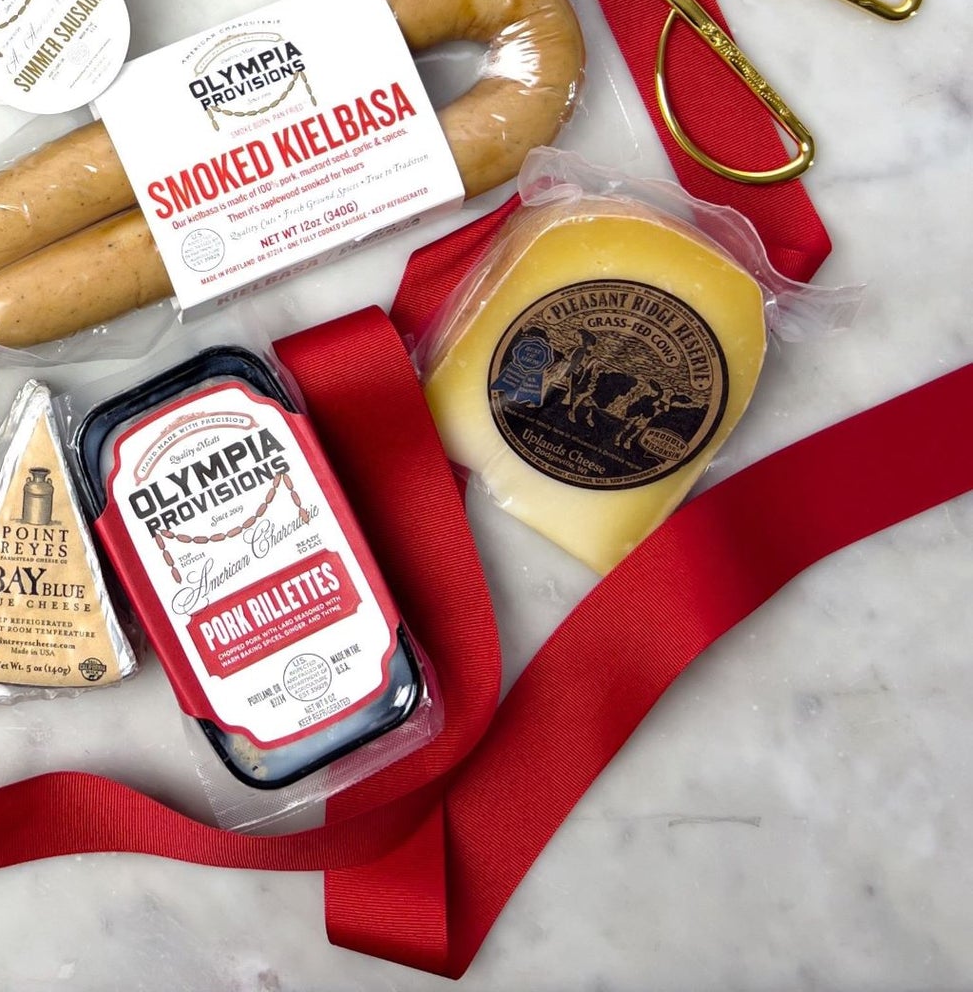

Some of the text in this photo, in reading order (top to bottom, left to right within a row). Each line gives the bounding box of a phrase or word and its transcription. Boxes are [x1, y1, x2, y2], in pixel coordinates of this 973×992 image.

[14, 37, 64, 93] SUMMER
[188, 41, 303, 99] OLYMPIA
[200, 59, 306, 111] PROVISIONS
[148, 82, 417, 220] SMOKED KIELBASA
[172, 137, 383, 231] Our kielbasa is made of mustard garlic &
[228, 161, 365, 223] Then applewood smoked for hours
[260, 202, 359, 249] NET WT 12oz (340G)
[200, 233, 317, 286] MADE FULLY
[551, 292, 629, 320] PLEASANT
[632, 295, 679, 328] RIDGE
[673, 323, 711, 382] RESERVE
[587, 317, 678, 364] GRASS-FED COWS
[179, 416, 245, 434] WITH PRECISION
[643, 438, 680, 459] WISCONSIN
[647, 430, 686, 450] PROUDLY
[128, 427, 286, 520] OLYMPIA
[521, 428, 567, 456] Uplands
[568, 449, 606, 475] Cheese
[145, 455, 291, 539] PROVISIONS
[210, 510, 229, 528] Since
[1, 541, 68, 558] REYES
[2, 526, 69, 543] POINT
[295, 533, 321, 549] READY
[26, 599, 91, 612] CHEESE
[42, 583, 86, 599] BLUE
[171, 552, 252, 616] American
[199, 561, 341, 653] PORK RILLETTES
[10, 617, 74, 628] REFRIGERATED
[217, 595, 342, 660] CHOPPED PORK WITH LARD SEASONED WITH
[221, 604, 343, 668] WARM BAKING AND THYME
